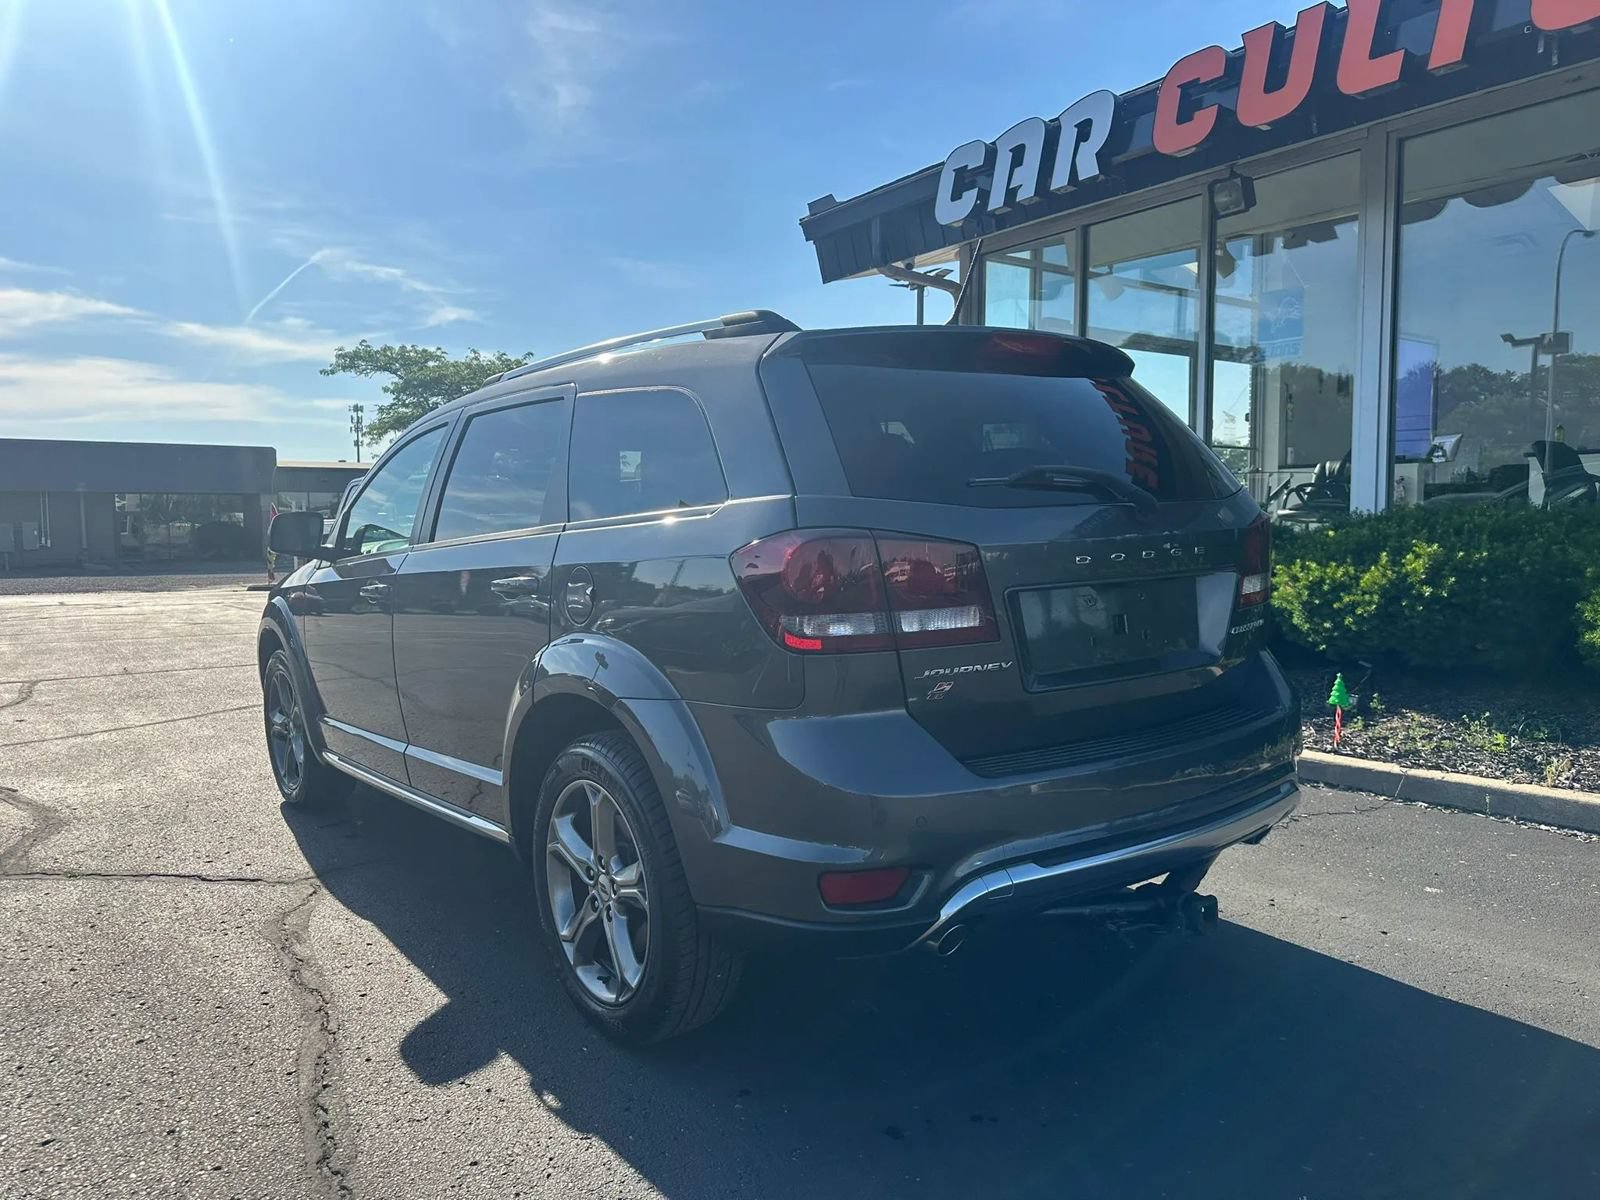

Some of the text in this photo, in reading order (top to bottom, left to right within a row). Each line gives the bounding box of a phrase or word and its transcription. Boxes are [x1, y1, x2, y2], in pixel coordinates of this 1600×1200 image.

[935, 0, 1600, 225] CAR CUL
[1075, 546, 1205, 564] DODGE
[914, 661, 1013, 680] JOURNEY
